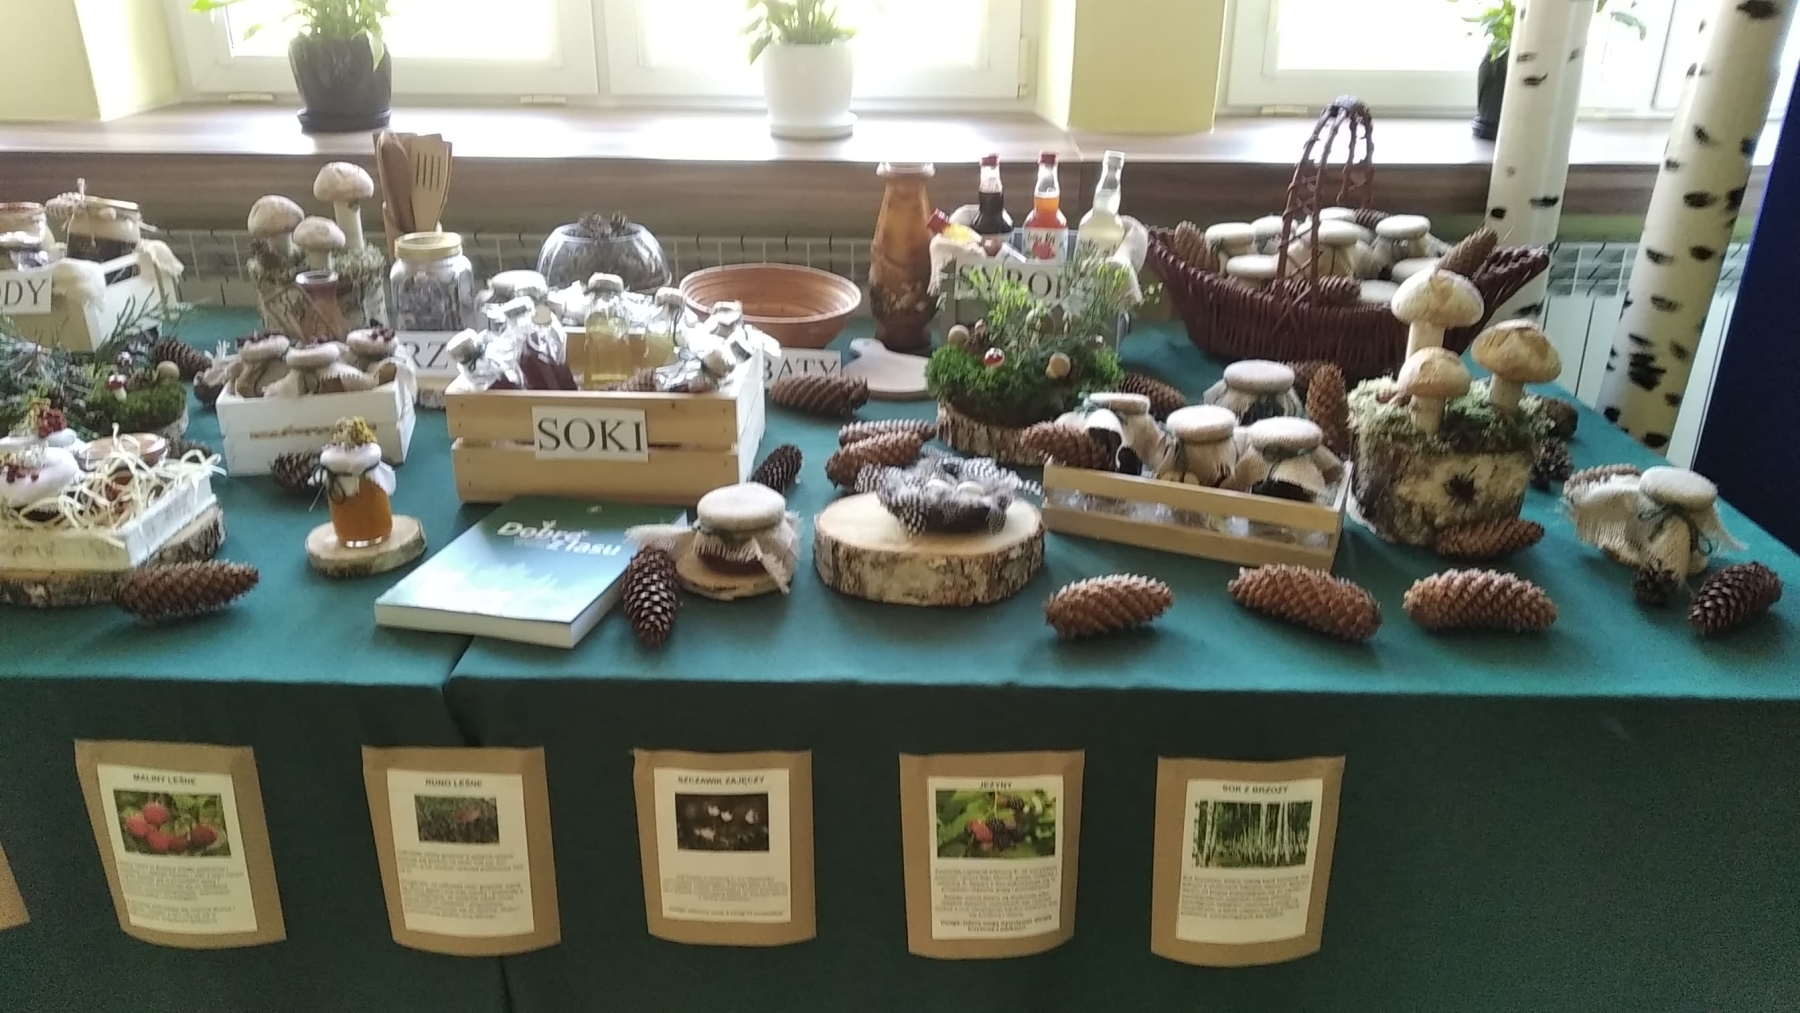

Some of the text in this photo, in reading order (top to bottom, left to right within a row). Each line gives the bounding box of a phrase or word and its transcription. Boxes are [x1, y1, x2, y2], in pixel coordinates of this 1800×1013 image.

[0, 278, 47, 306] DY
[537, 417, 642, 453] SOKI
[133, 772, 165, 784] MALINY
[425, 778, 451, 788] RUNO
